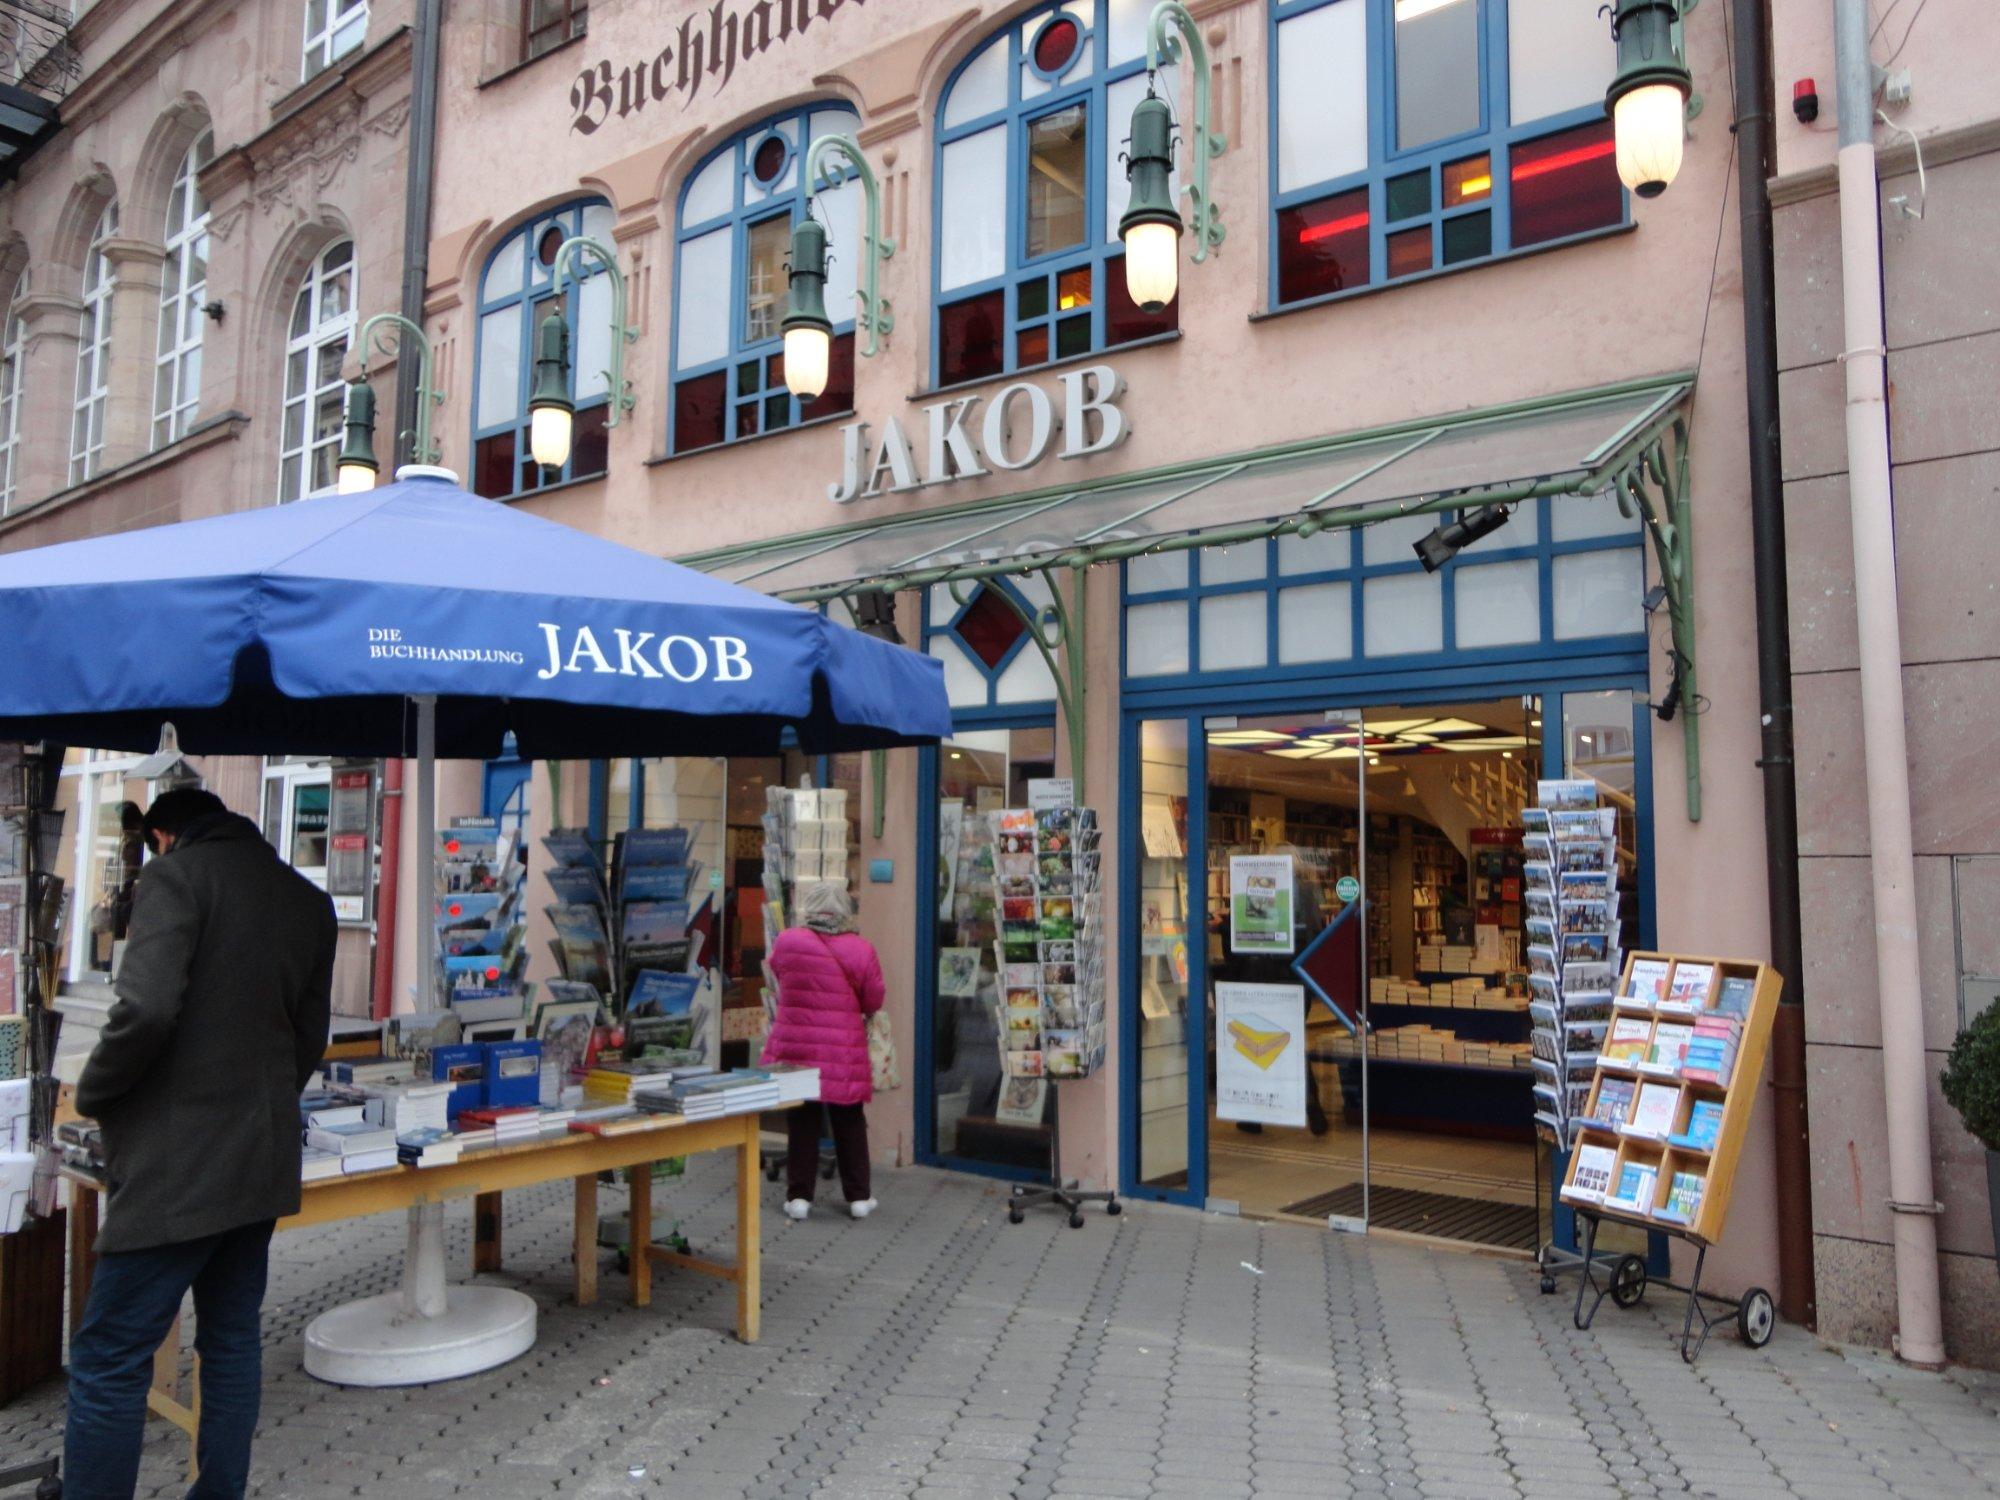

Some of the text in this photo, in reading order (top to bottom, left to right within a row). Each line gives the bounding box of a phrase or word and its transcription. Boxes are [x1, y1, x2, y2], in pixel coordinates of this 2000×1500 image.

[569, 0, 866, 137] Buchhan
[826, 365, 1132, 504] JAKOB
[368, 628, 402, 642] DIE
[369, 644, 524, 665] BUCHHANDLUNG
[537, 622, 753, 683] JAKOB
